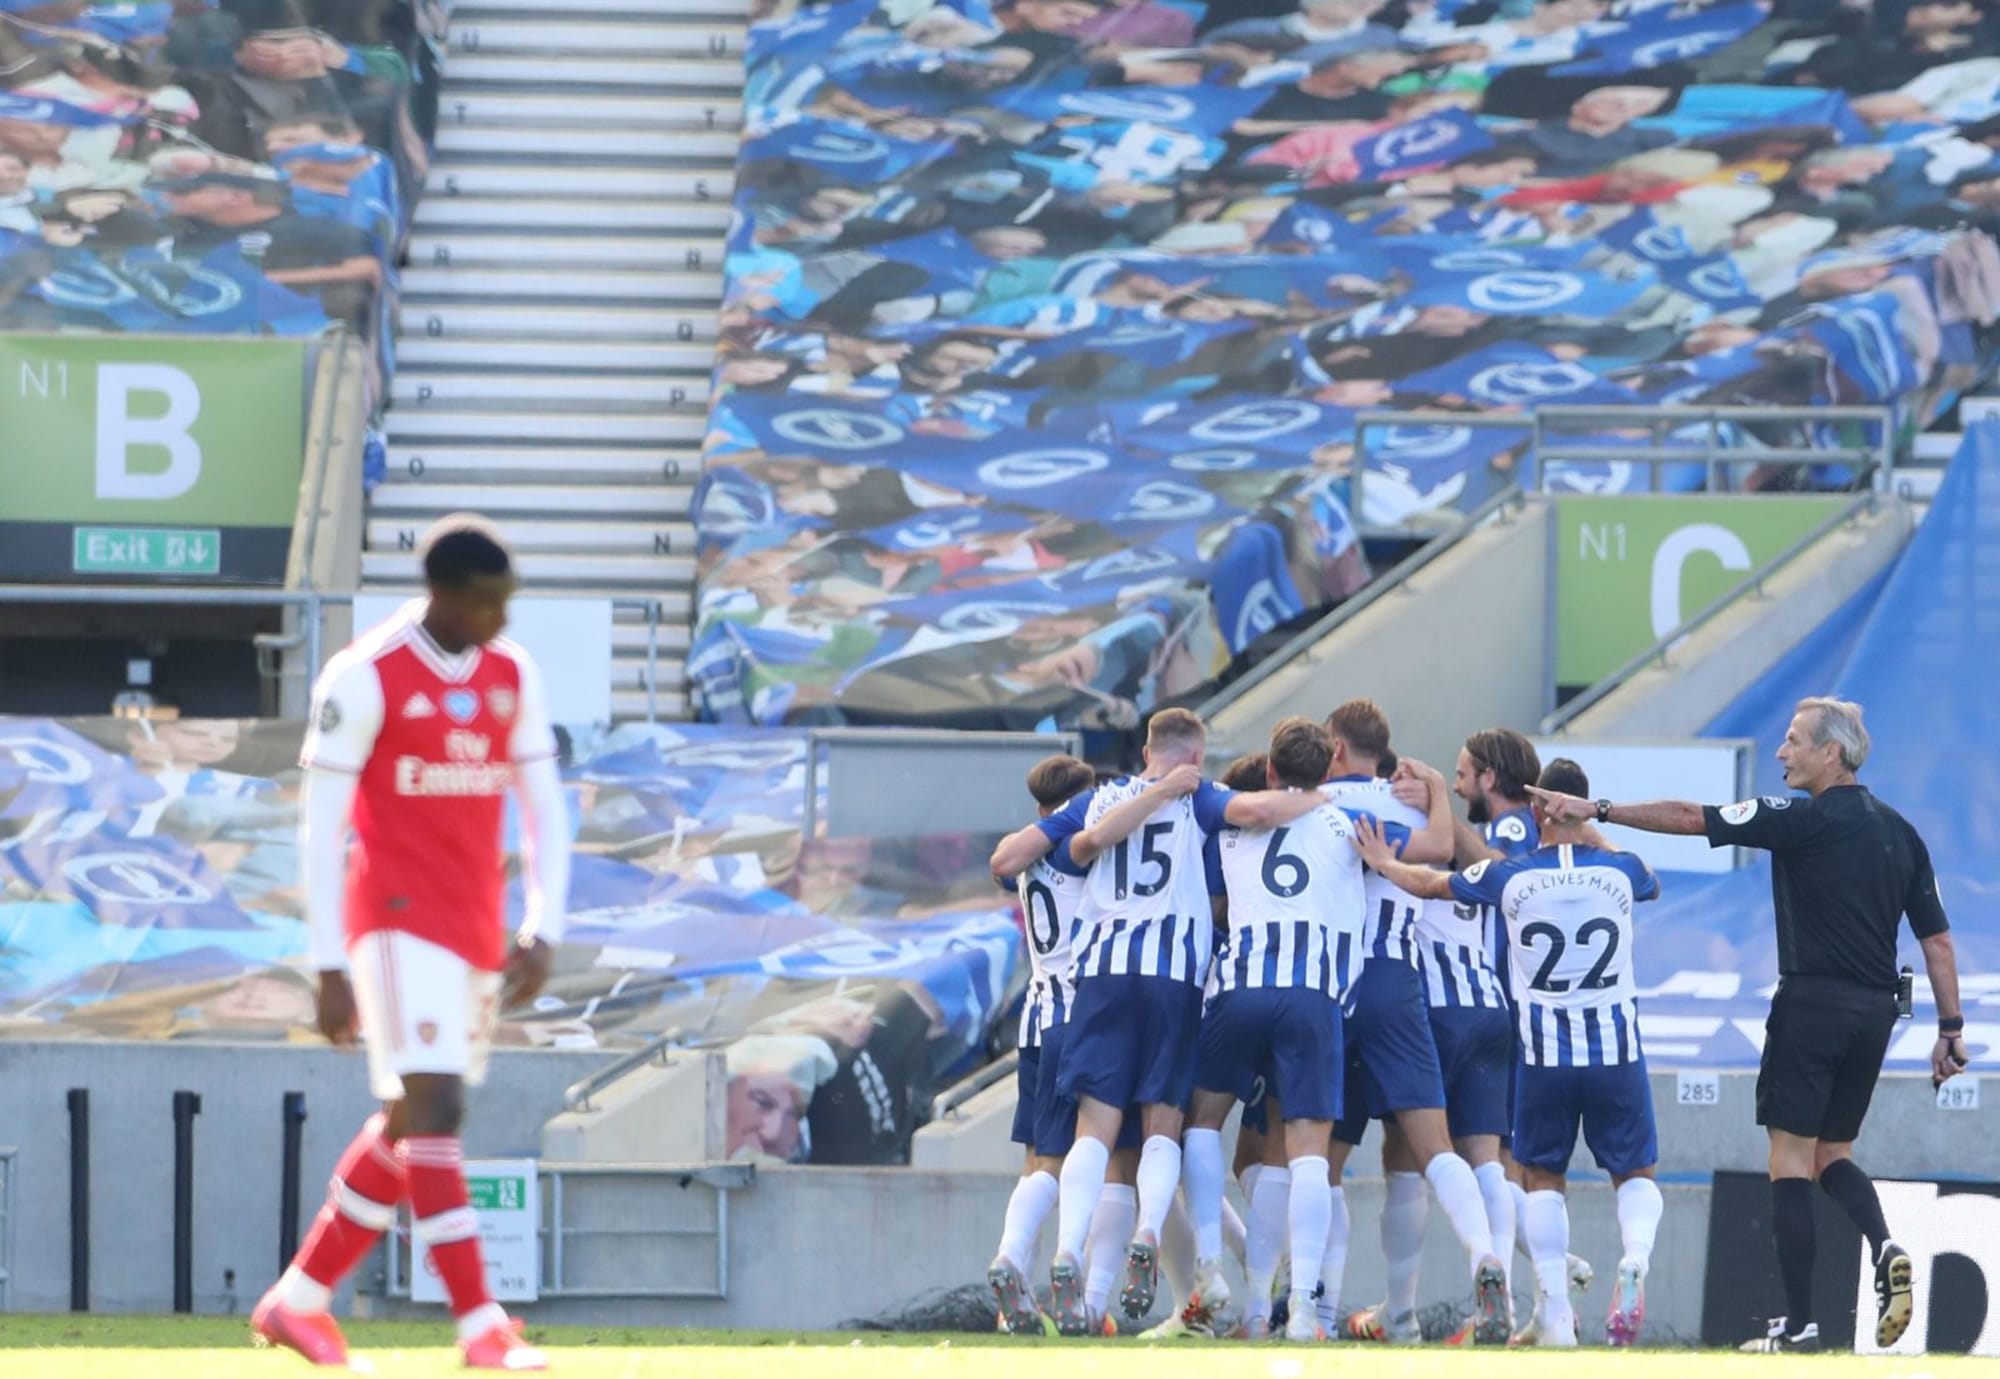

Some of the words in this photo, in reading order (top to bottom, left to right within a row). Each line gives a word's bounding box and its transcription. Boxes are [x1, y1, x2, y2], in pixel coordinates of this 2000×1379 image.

[709, 38, 727, 56] U
[454, 105, 467, 122] T
[704, 109, 716, 128] T
[20, 360, 68, 398] N1
[418, 386, 432, 404] P
[671, 389, 685, 408] P
[95, 363, 201, 500] B
[87, 534, 149, 563] Exit
[400, 531, 415, 551] N
[654, 533, 671, 553] N
[1580, 523, 1627, 560] N1
[1115, 821, 1175, 900] 15
[1261, 827, 1310, 898] 6
[1508, 882, 1539, 921] BLACK
[1541, 872, 1585, 890] LIVES
[1588, 876, 1630, 917] MATTER
[1520, 917, 1620, 992] 22
[1681, 1083, 1715, 1101] 285
[1941, 1087, 1975, 1107] 287
